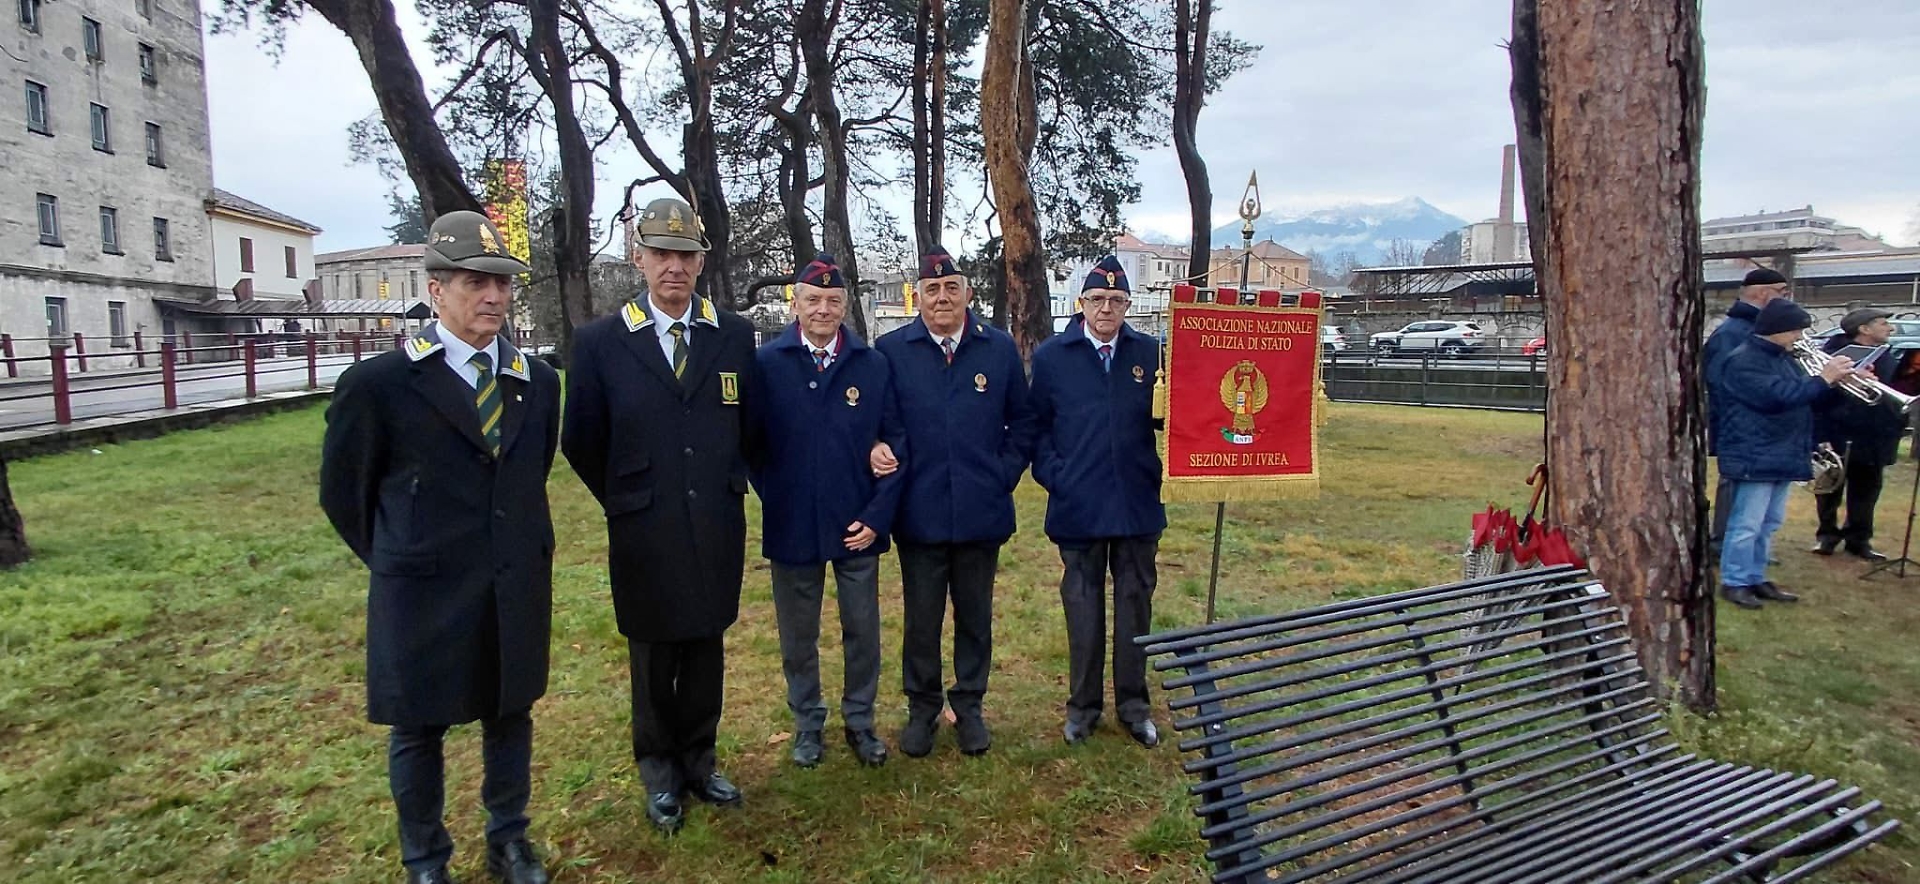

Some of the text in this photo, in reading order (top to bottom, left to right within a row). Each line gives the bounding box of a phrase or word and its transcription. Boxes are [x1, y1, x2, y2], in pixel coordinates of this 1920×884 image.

[1179, 316, 1313, 334] ASSOCIAZIONE NAZIONALE
[1200, 334, 1292, 351] POLIZIA DI STATO
[1189, 452, 1290, 467] SEZIONE DI IVREA
